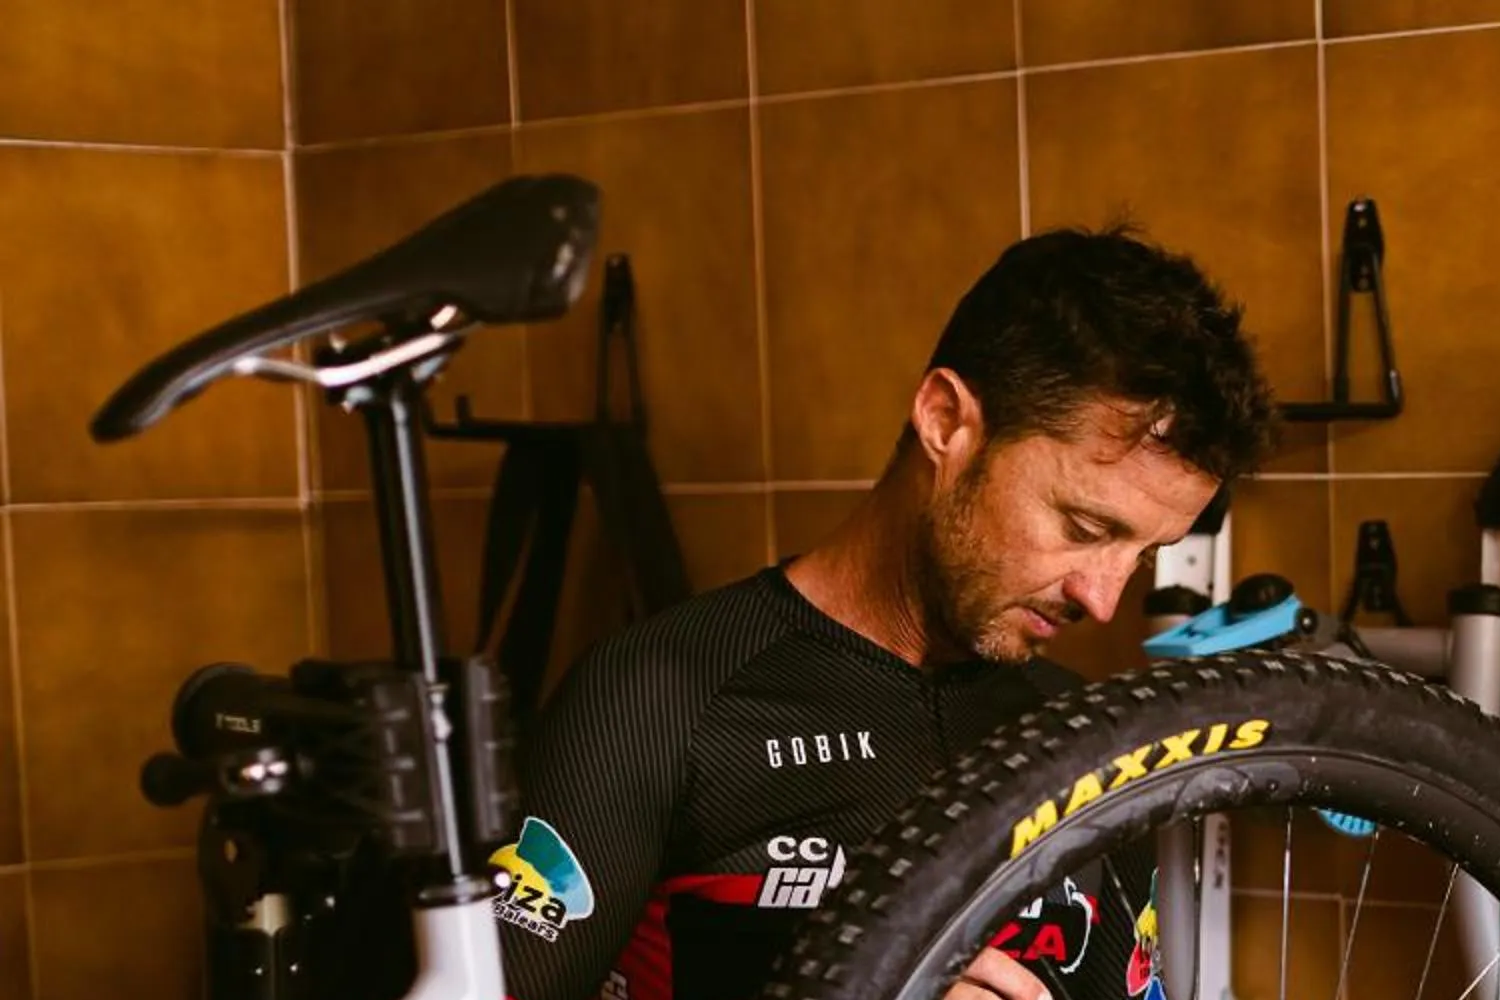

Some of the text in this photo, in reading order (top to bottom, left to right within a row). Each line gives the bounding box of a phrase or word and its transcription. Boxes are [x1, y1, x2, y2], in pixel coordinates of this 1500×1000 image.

[766, 731, 877, 769] GOBIK
[1010, 719, 1271, 861] MAXXIS
[767, 835, 829, 862] CC
[503, 872, 567, 927] iza
